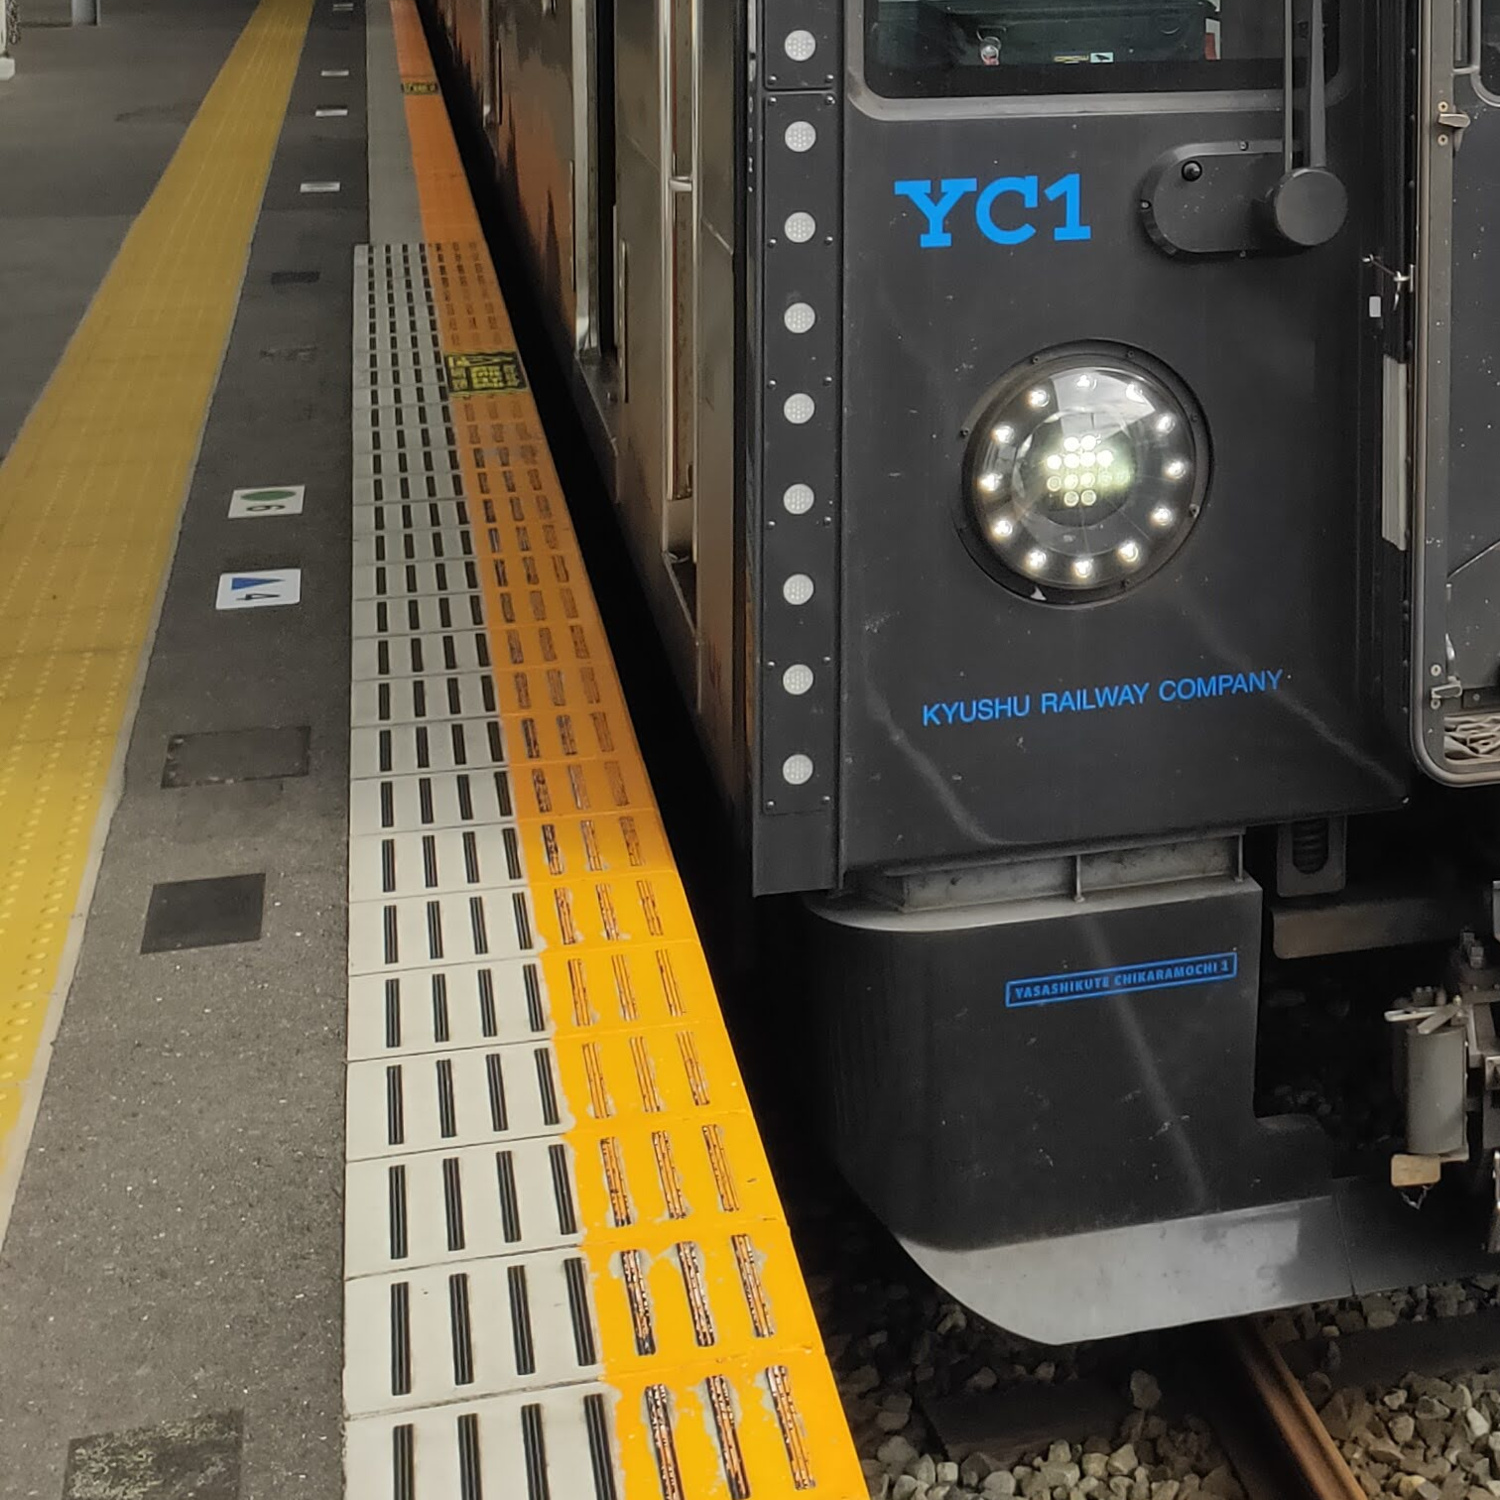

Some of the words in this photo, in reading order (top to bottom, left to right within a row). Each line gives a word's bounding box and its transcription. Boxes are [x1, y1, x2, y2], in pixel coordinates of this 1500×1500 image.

[894, 172, 1092, 249] YC1
[922, 694, 1030, 727] KYUSHU
[1041, 682, 1151, 714] RAILWAY
[1158, 668, 1283, 702] COMPANY
[1015, 976, 1110, 999] YASASHIKUTE
[1114, 965, 1218, 987] CHIKARAMOCHI
